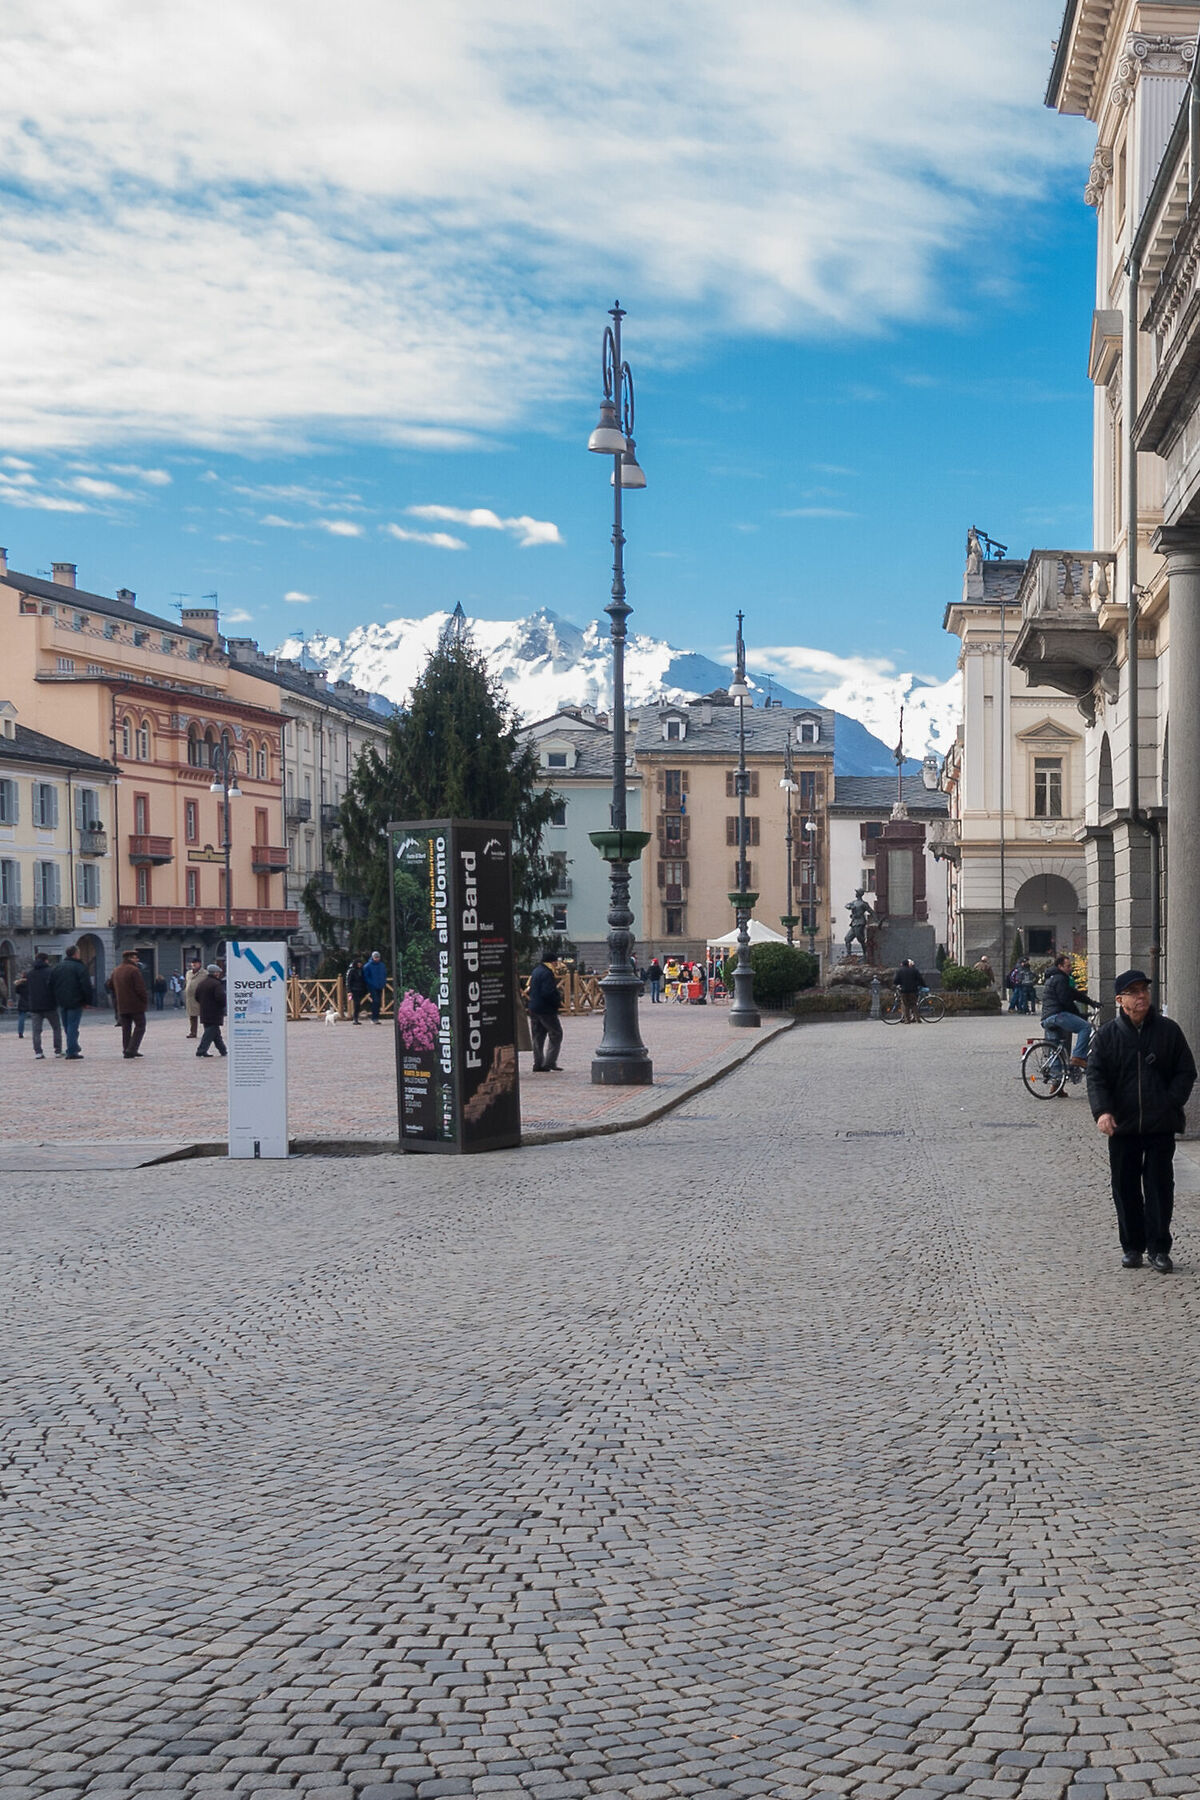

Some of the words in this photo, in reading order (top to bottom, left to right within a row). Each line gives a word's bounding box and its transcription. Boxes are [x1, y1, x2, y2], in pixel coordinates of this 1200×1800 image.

[435, 837, 448, 944] all'Uomo
[461, 851, 478, 931] Bard
[234, 979, 272, 989] sveart
[438, 951, 449, 1010] Terra
[463, 941, 479, 972] di
[439, 1016, 452, 1074] dalla
[466, 981, 482, 1069] Forte
